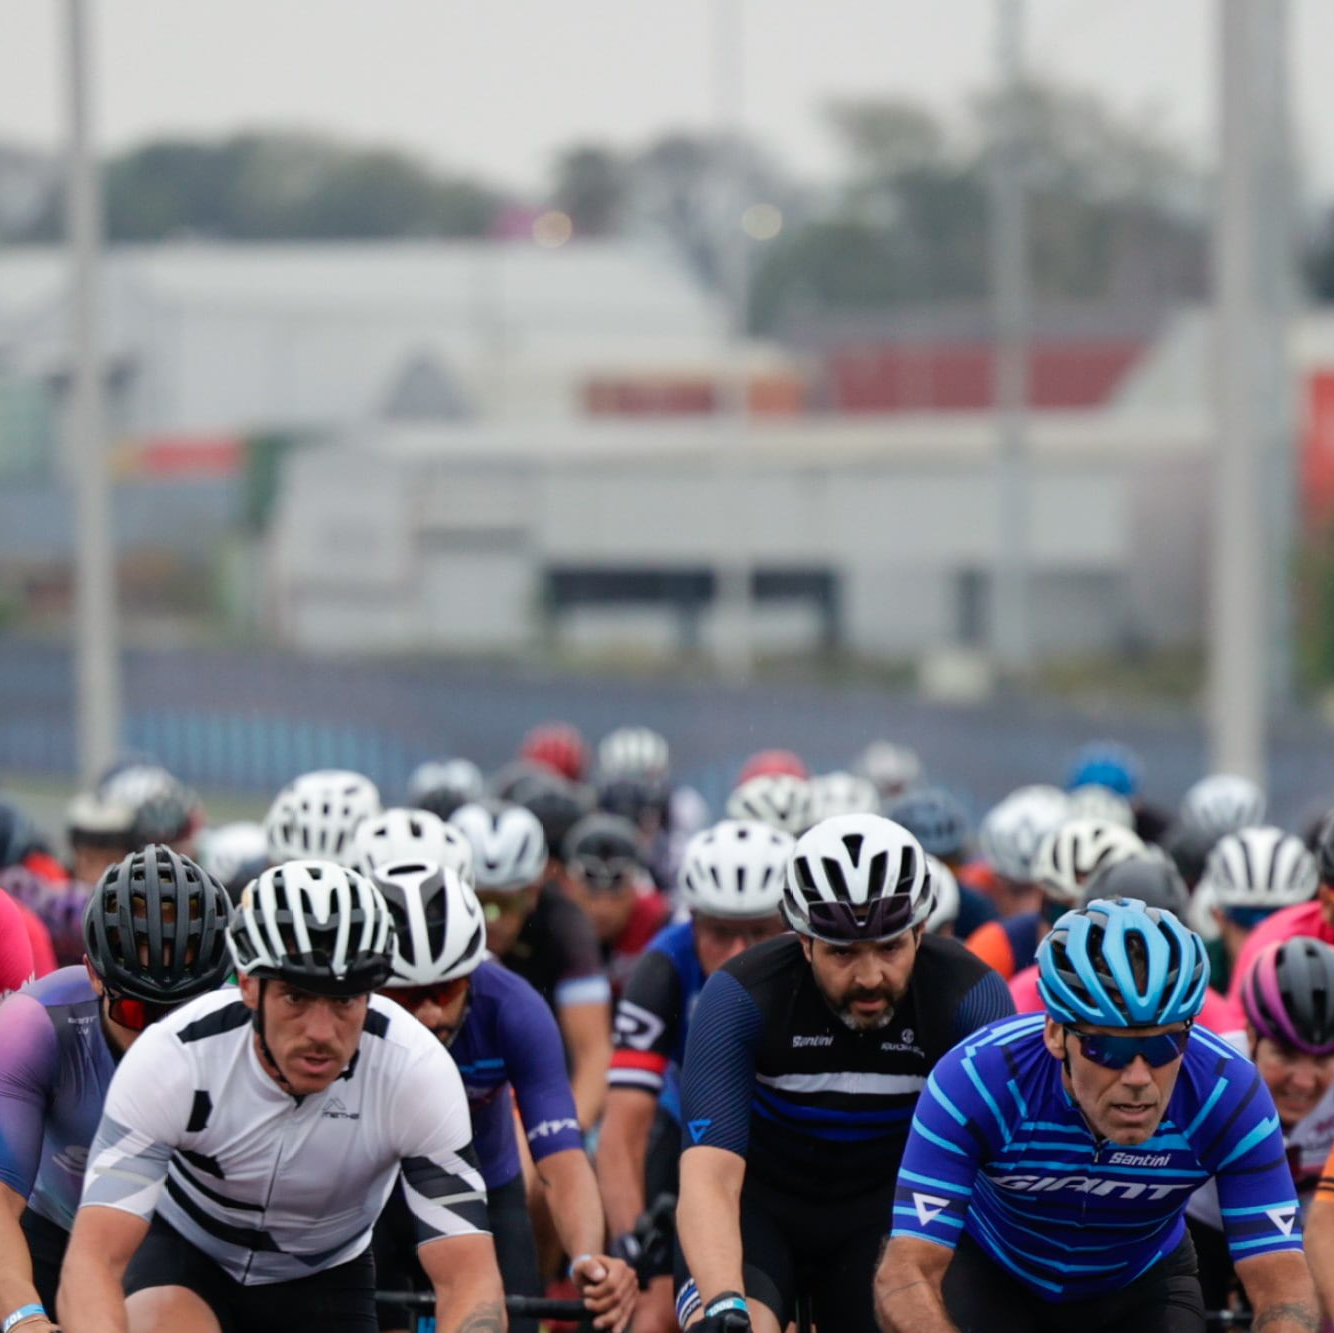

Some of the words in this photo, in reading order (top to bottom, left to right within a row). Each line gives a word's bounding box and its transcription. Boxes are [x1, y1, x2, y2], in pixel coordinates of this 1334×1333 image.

[792, 1035, 834, 1048] Santini
[1108, 1152, 1171, 1167] Santini
[990, 1174, 1196, 1201] GIANT
